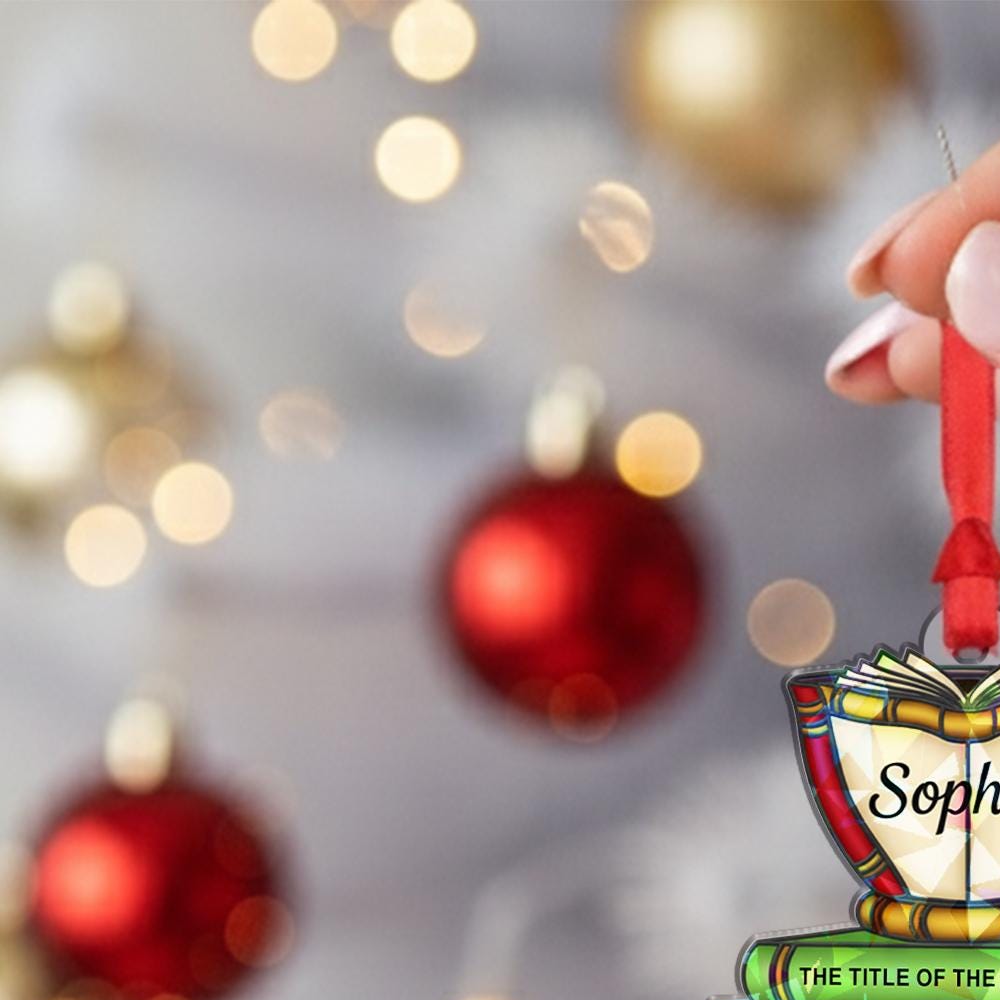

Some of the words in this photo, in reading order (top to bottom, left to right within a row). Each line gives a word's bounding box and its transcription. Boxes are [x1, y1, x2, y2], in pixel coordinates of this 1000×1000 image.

[800, 968, 841, 985] THE
[849, 968, 909, 986] TITLE
[917, 969, 945, 986] OF
[953, 969, 994, 986] THE
